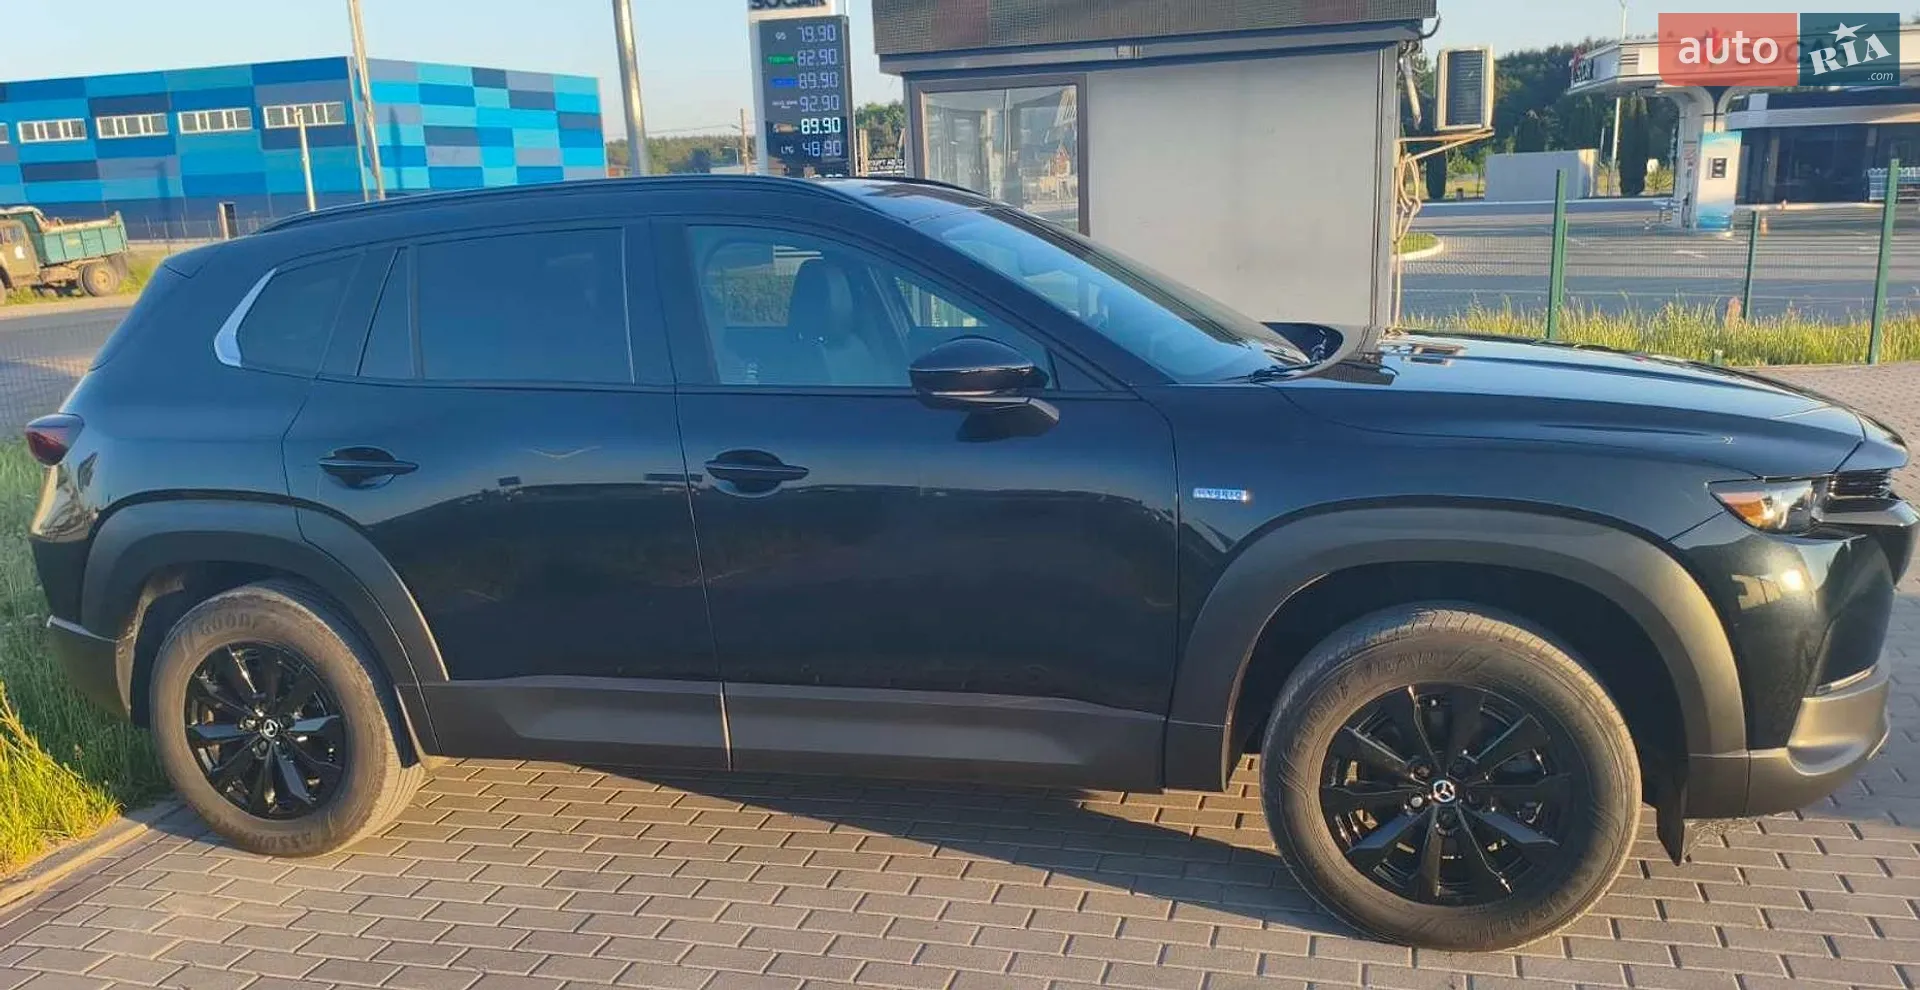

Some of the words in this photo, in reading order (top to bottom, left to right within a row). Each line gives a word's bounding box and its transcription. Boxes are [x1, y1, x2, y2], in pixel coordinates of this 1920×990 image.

[796, 24, 836, 42] 79.90
[797, 48, 837, 66] 82.90
[799, 71, 839, 89] 89.90
[800, 95, 840, 113] 92.90
[801, 117, 841, 135] 89.90
